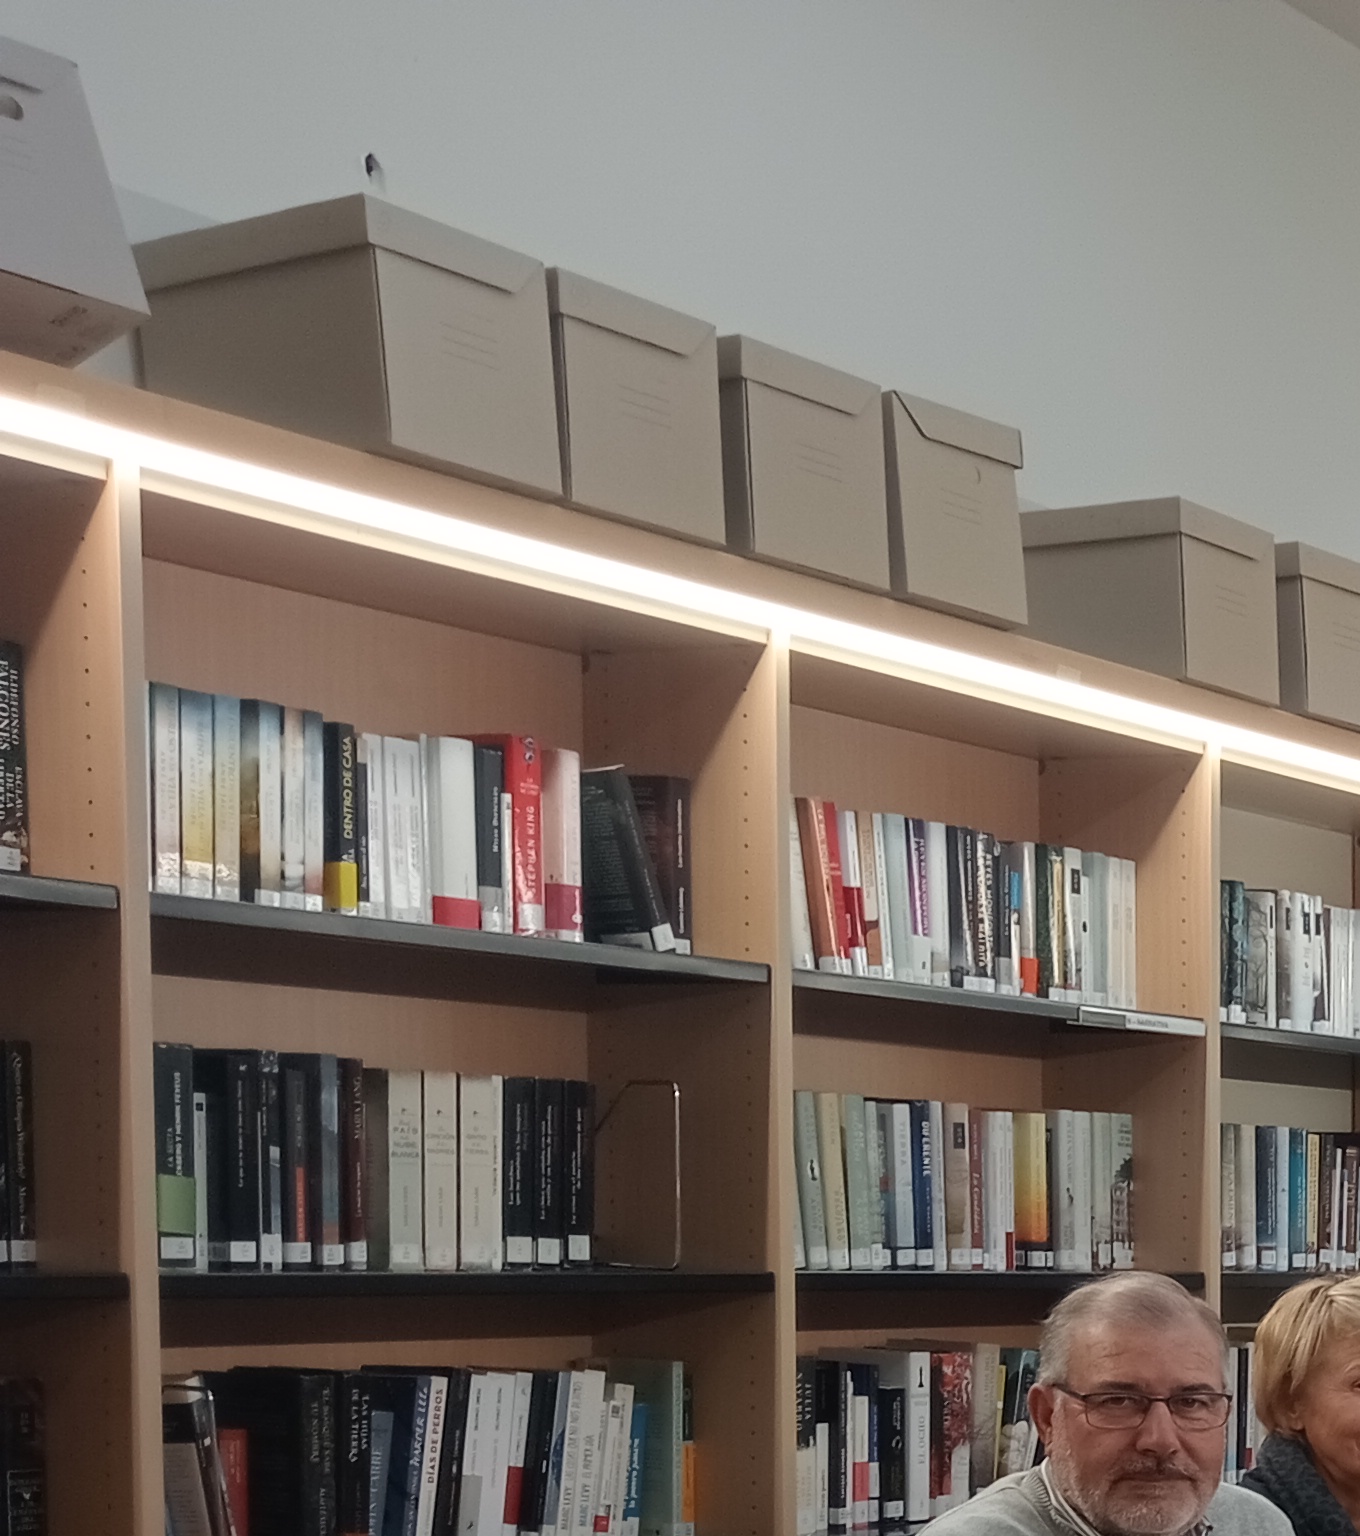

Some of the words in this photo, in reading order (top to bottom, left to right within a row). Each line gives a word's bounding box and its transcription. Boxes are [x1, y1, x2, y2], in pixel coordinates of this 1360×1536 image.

[343, 736, 353, 768] CASA
[344, 769, 353, 790] DE
[343, 791, 353, 840] DENTRO
[525, 805, 536, 837] KING
[921, 1120, 931, 1177] DIFERENTE
[432, 1388, 444, 1435] PERROS
[804, 1382, 812, 1420] JULIA
[348, 1423, 360, 1463] TIERRA
[430, 1437, 439, 1454] DE
[427, 1457, 437, 1485] DÍAS
